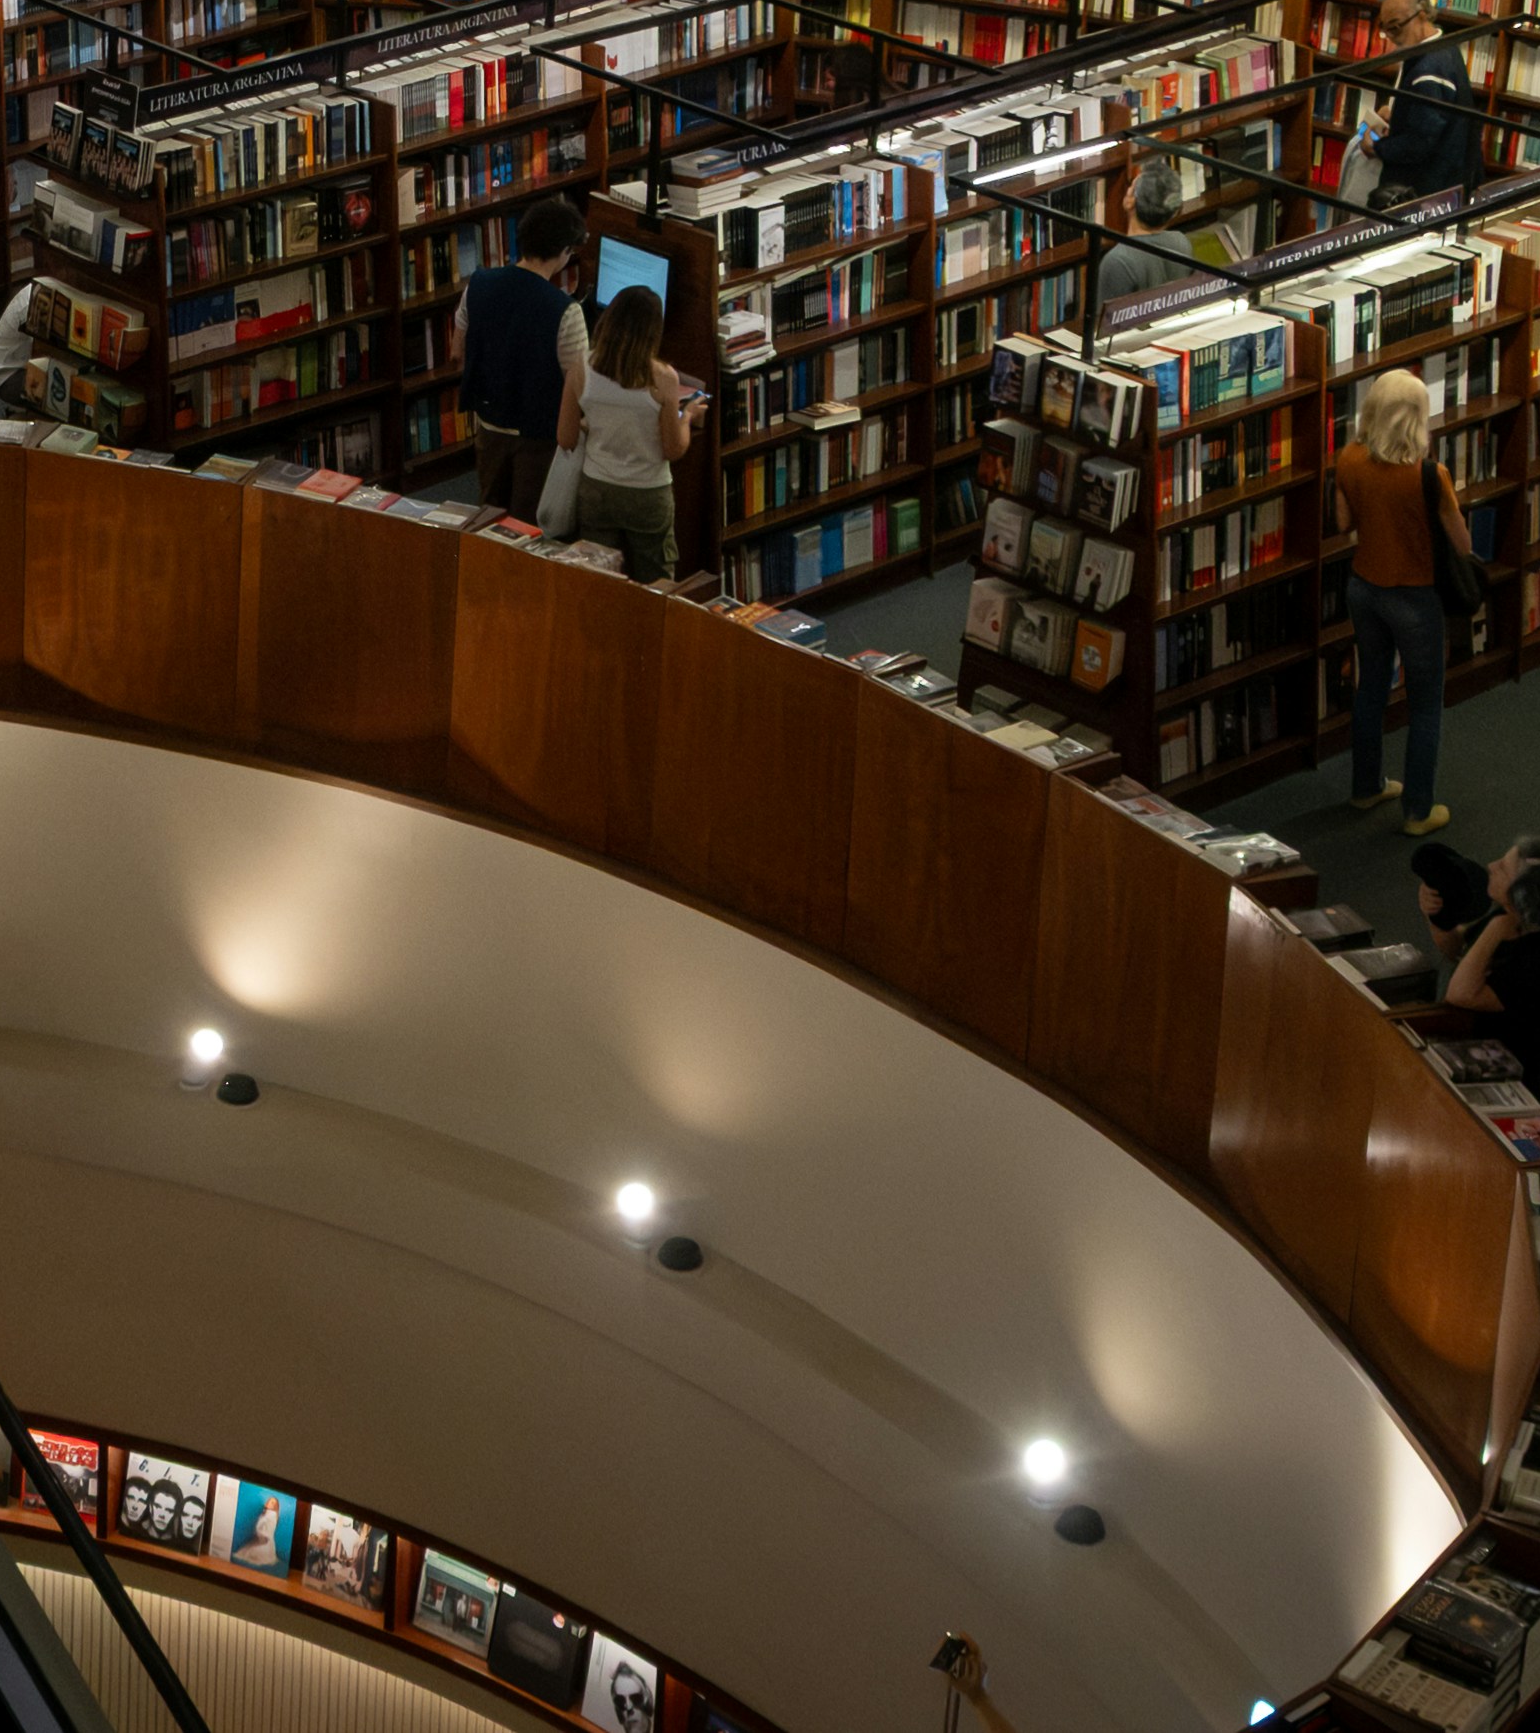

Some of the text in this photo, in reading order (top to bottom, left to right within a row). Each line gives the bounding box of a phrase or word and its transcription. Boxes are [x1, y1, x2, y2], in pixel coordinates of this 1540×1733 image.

[377, 4, 518, 53] LITERATURA ARGENTINA
[149, 81, 229, 113] LITERATURA
[232, 61, 304, 91] ARGENTINA
[1111, 297, 1166, 326] LITERATURA
[138, 1459, 150, 1474] G.
